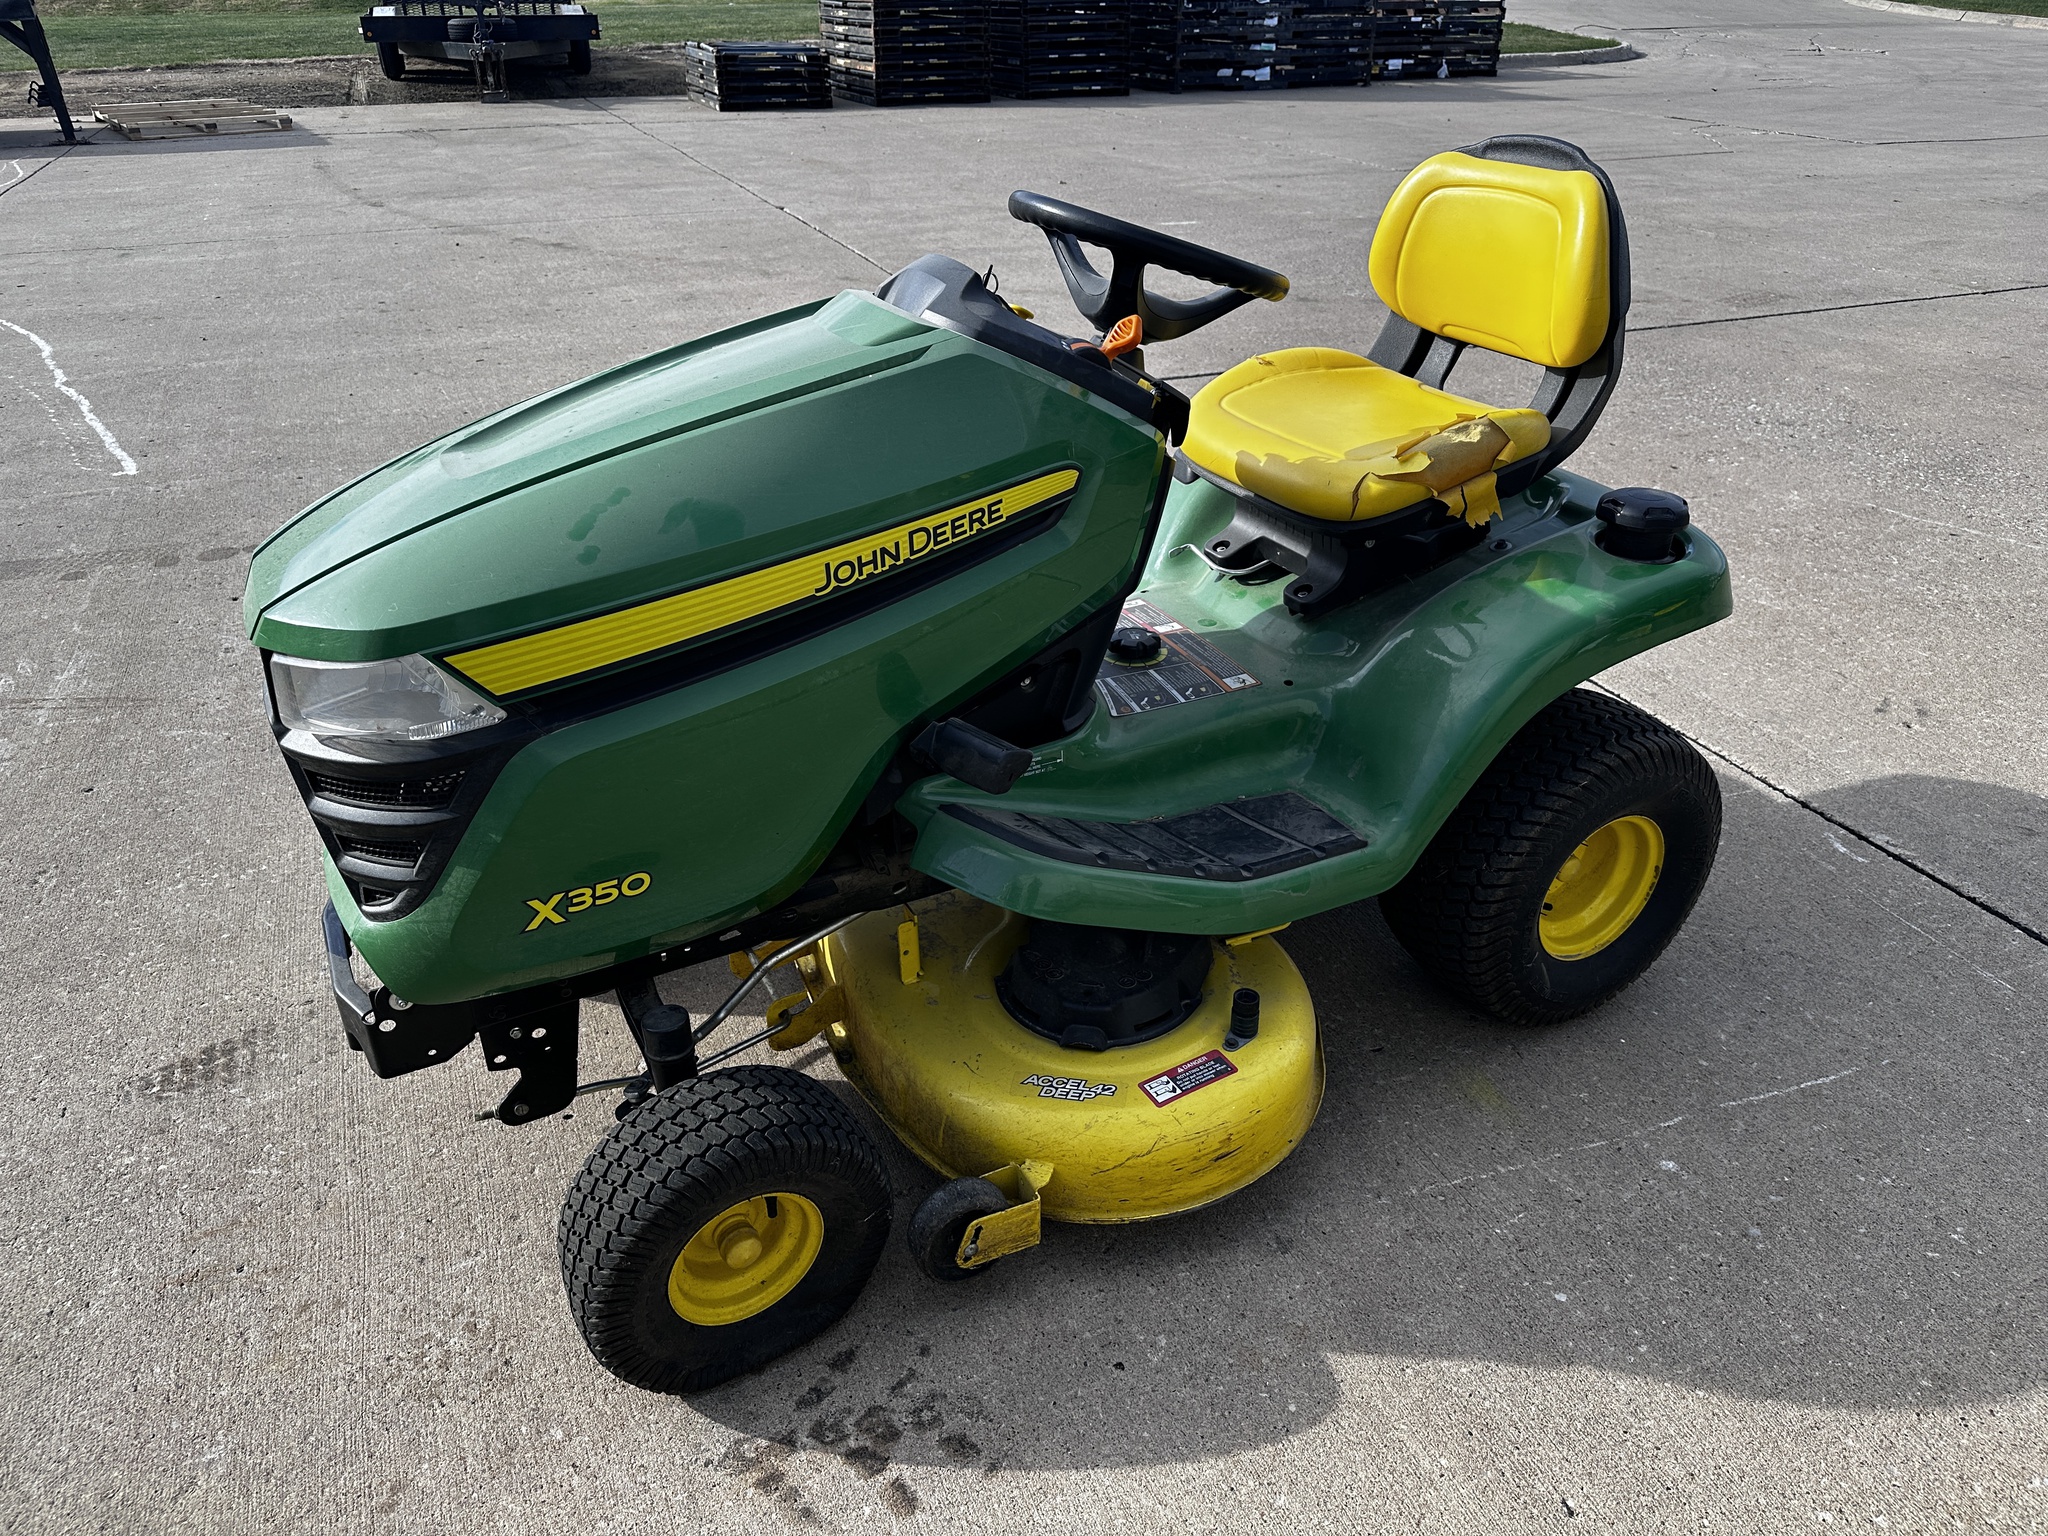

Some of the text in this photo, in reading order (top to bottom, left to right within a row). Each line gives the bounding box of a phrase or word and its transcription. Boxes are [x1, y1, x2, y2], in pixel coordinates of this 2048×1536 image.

[814, 498, 1005, 595] JOHN DEERE
[524, 871, 652, 932] X350
[1176, 1068, 1200, 1079] ROTATING
[1199, 1060, 1215, 1070] BLADE
[1183, 1056, 1208, 1070] DANGER
[1022, 1074, 1090, 1091] ACCEL
[1038, 1086, 1096, 1101] DEEP
